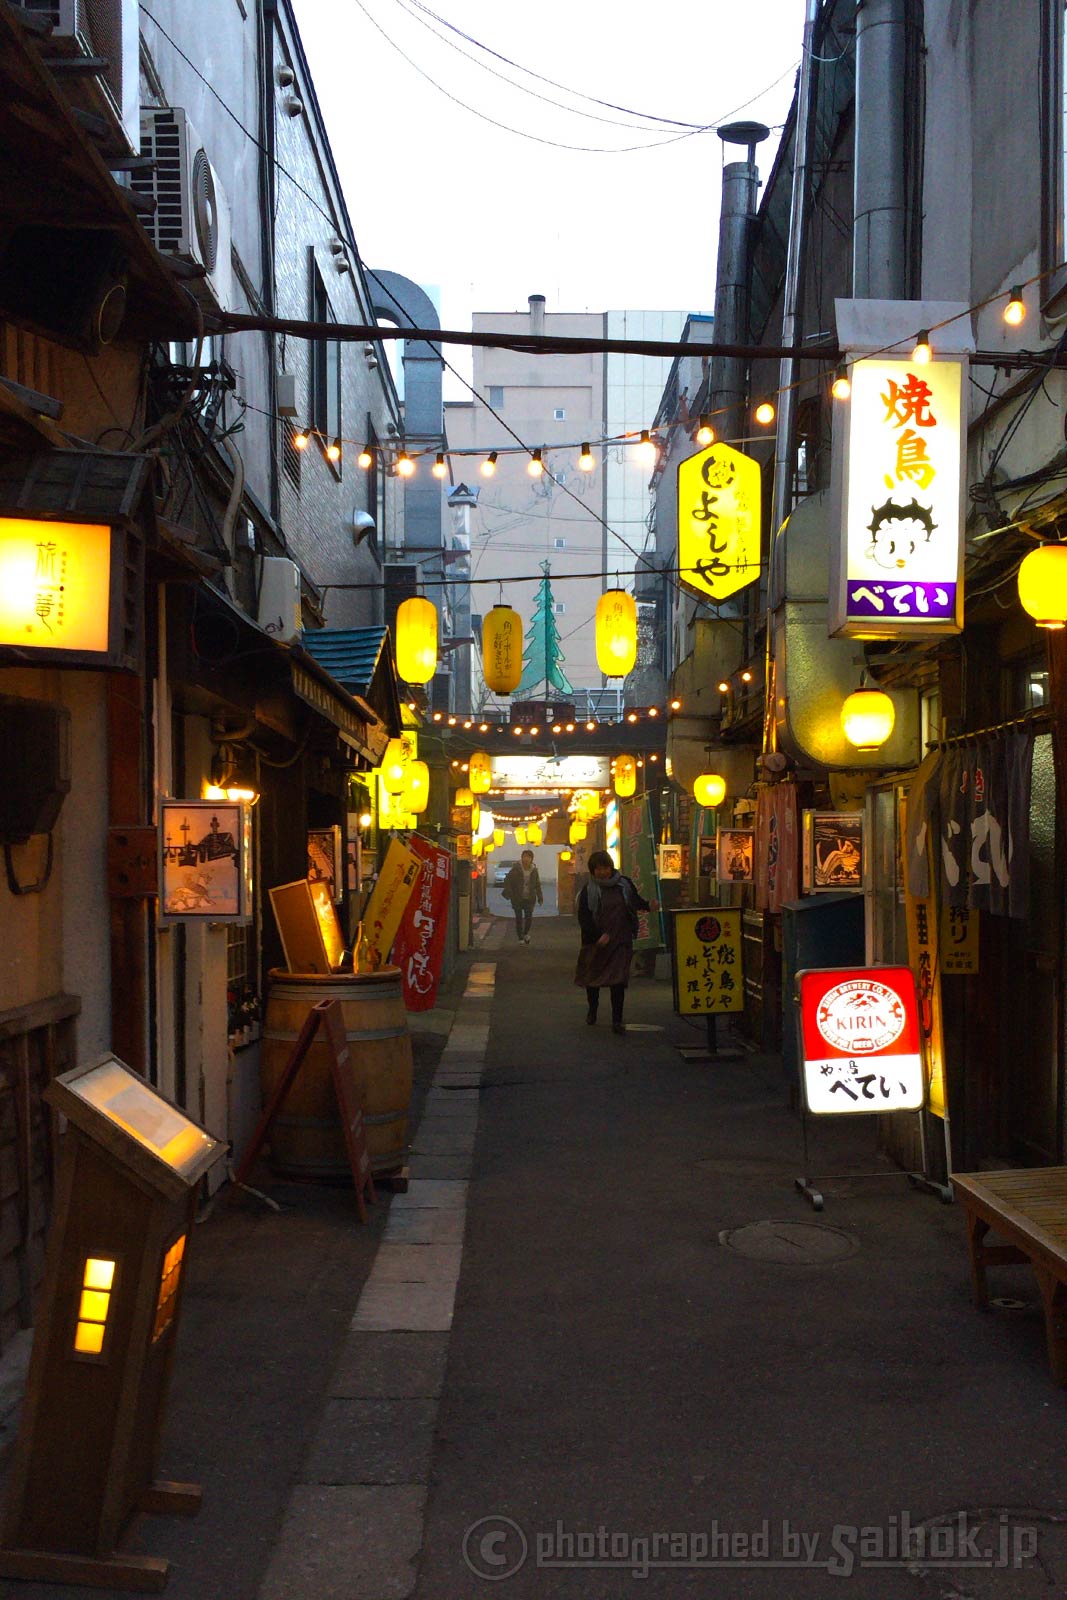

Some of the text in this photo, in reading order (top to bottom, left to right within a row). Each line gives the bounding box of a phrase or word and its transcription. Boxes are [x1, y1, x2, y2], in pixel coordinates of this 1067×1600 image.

[880, 373, 937, 490] 焼鳥
[692, 491, 730, 586] よしや
[851, 584, 949, 615] べてい
[836, 1015, 887, 1030] KIRIN
[829, 1073, 908, 1101] べてい
